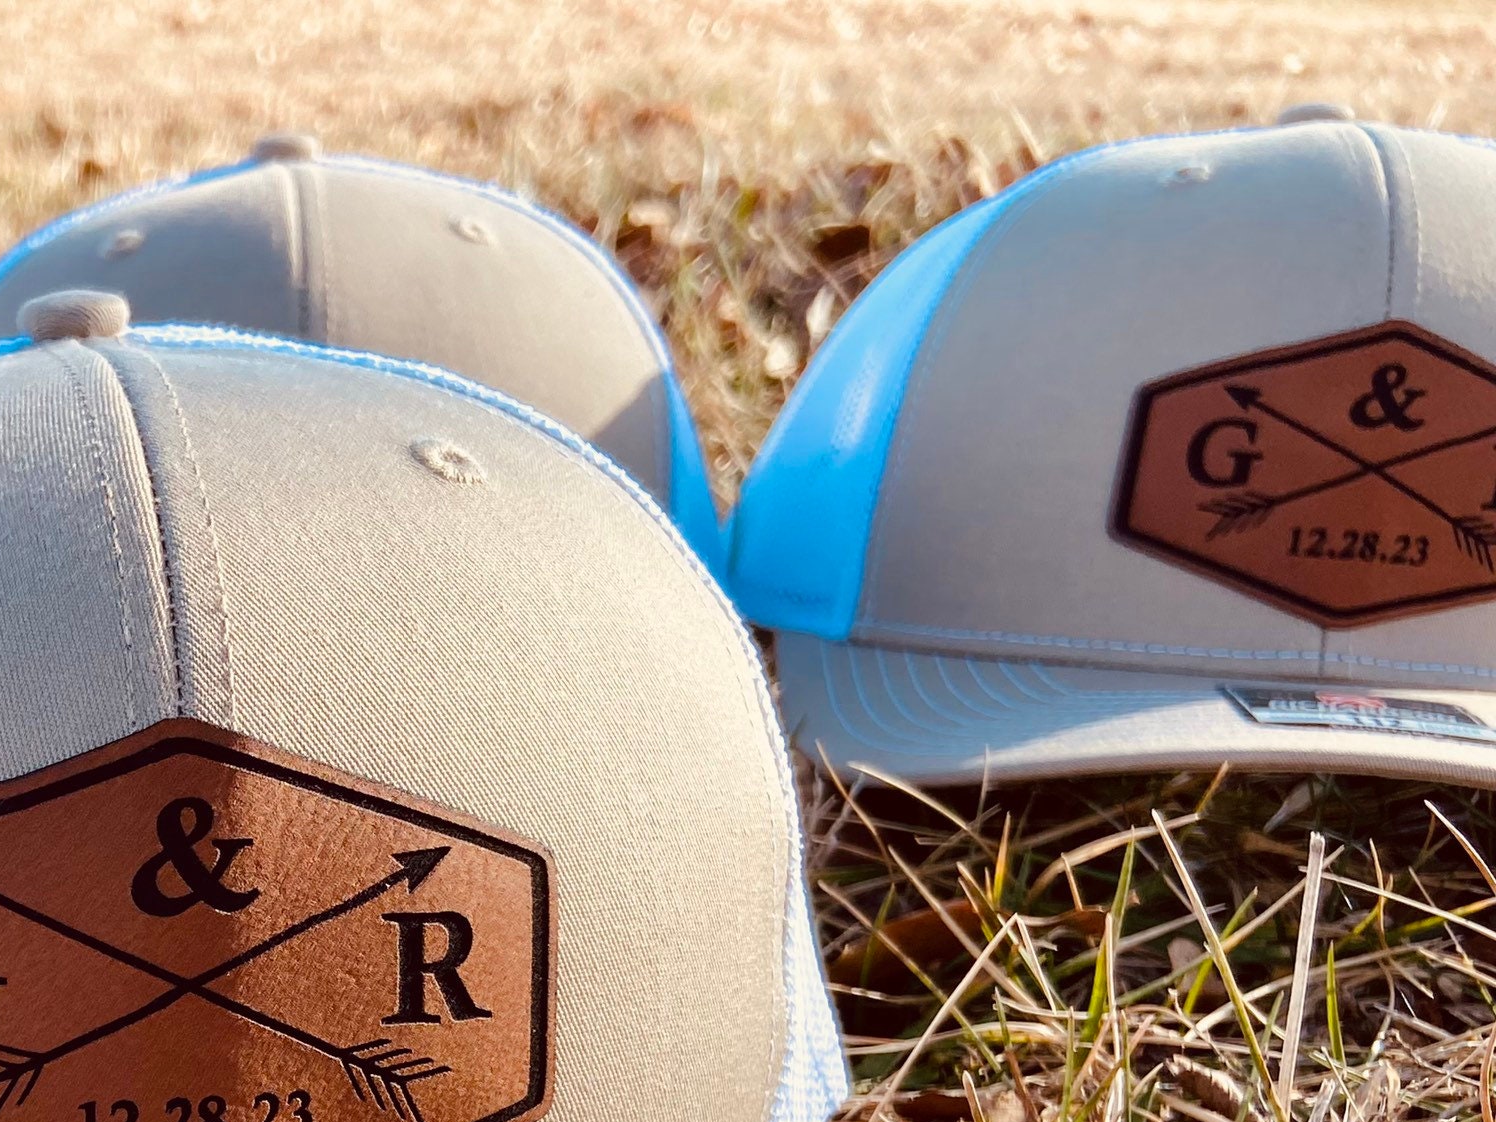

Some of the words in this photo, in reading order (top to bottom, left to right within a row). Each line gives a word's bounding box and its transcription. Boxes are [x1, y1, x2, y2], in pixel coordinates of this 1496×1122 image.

[1349, 364, 1425, 431] &
[1187, 418, 1263, 487] G
[1289, 527, 1429, 567] 12.28.23
[131, 797, 261, 917] &
[381, 910, 492, 1026] R
